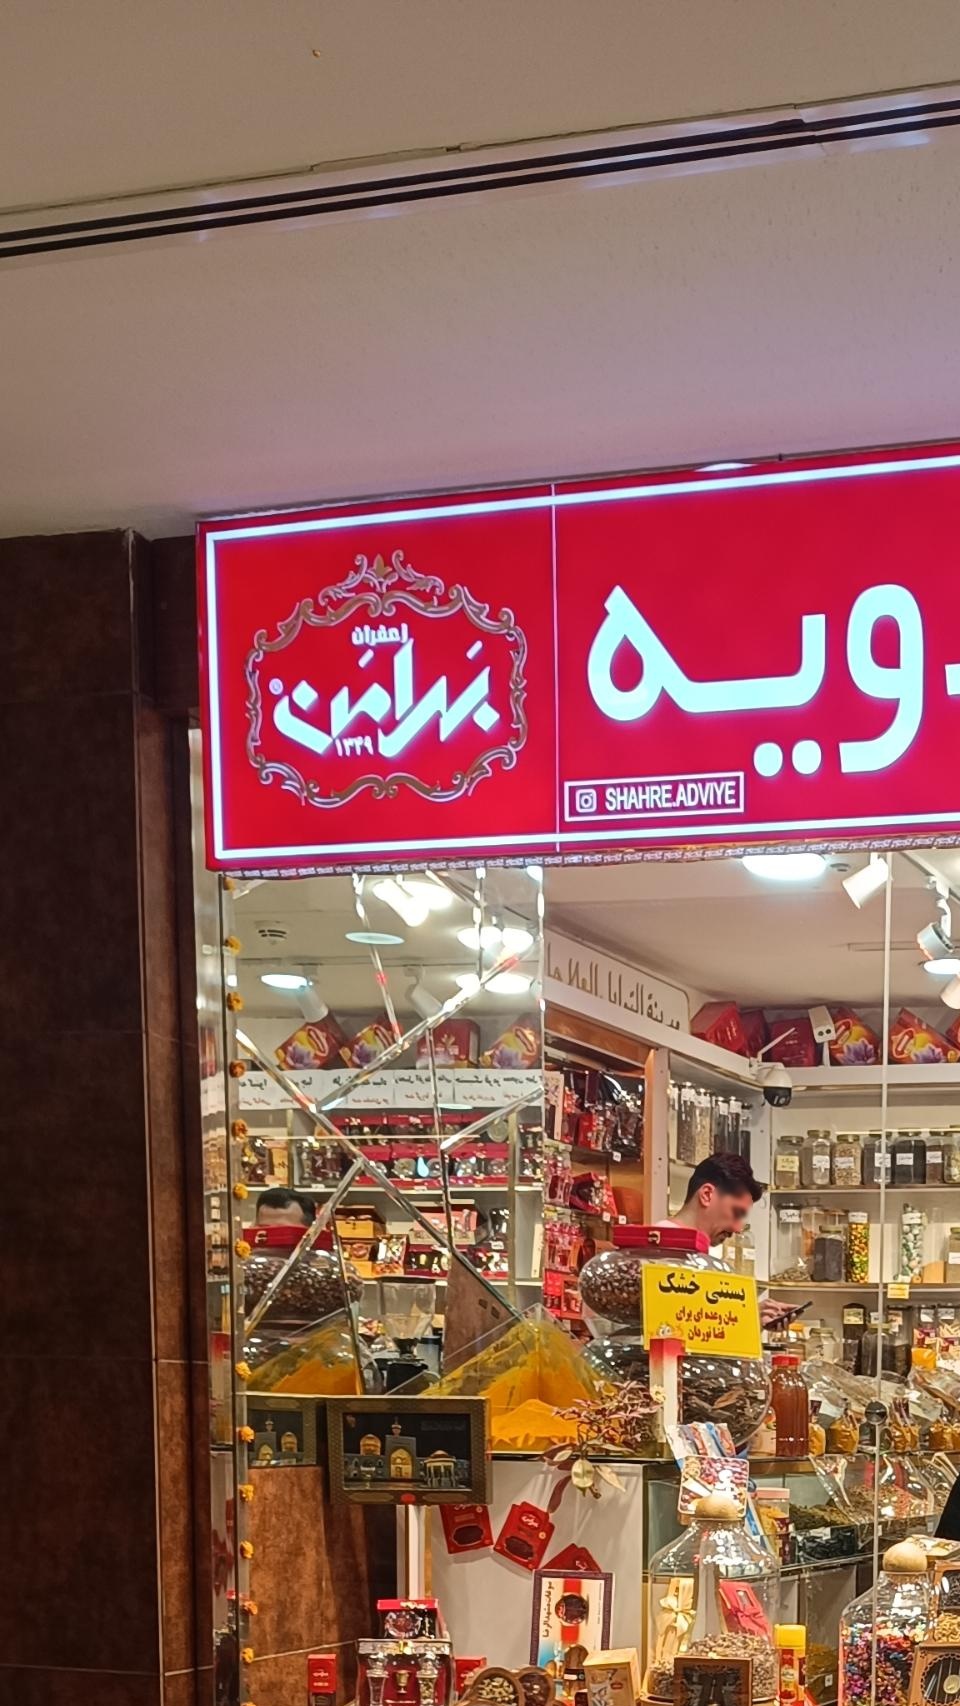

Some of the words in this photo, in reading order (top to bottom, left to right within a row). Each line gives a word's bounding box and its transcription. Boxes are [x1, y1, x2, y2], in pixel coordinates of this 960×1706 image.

[604, 780, 737, 812] SHAHRE.ADVIYE
[658, 1272, 700, 1295] خشک
[705, 1281, 746, 1308] بستنی
